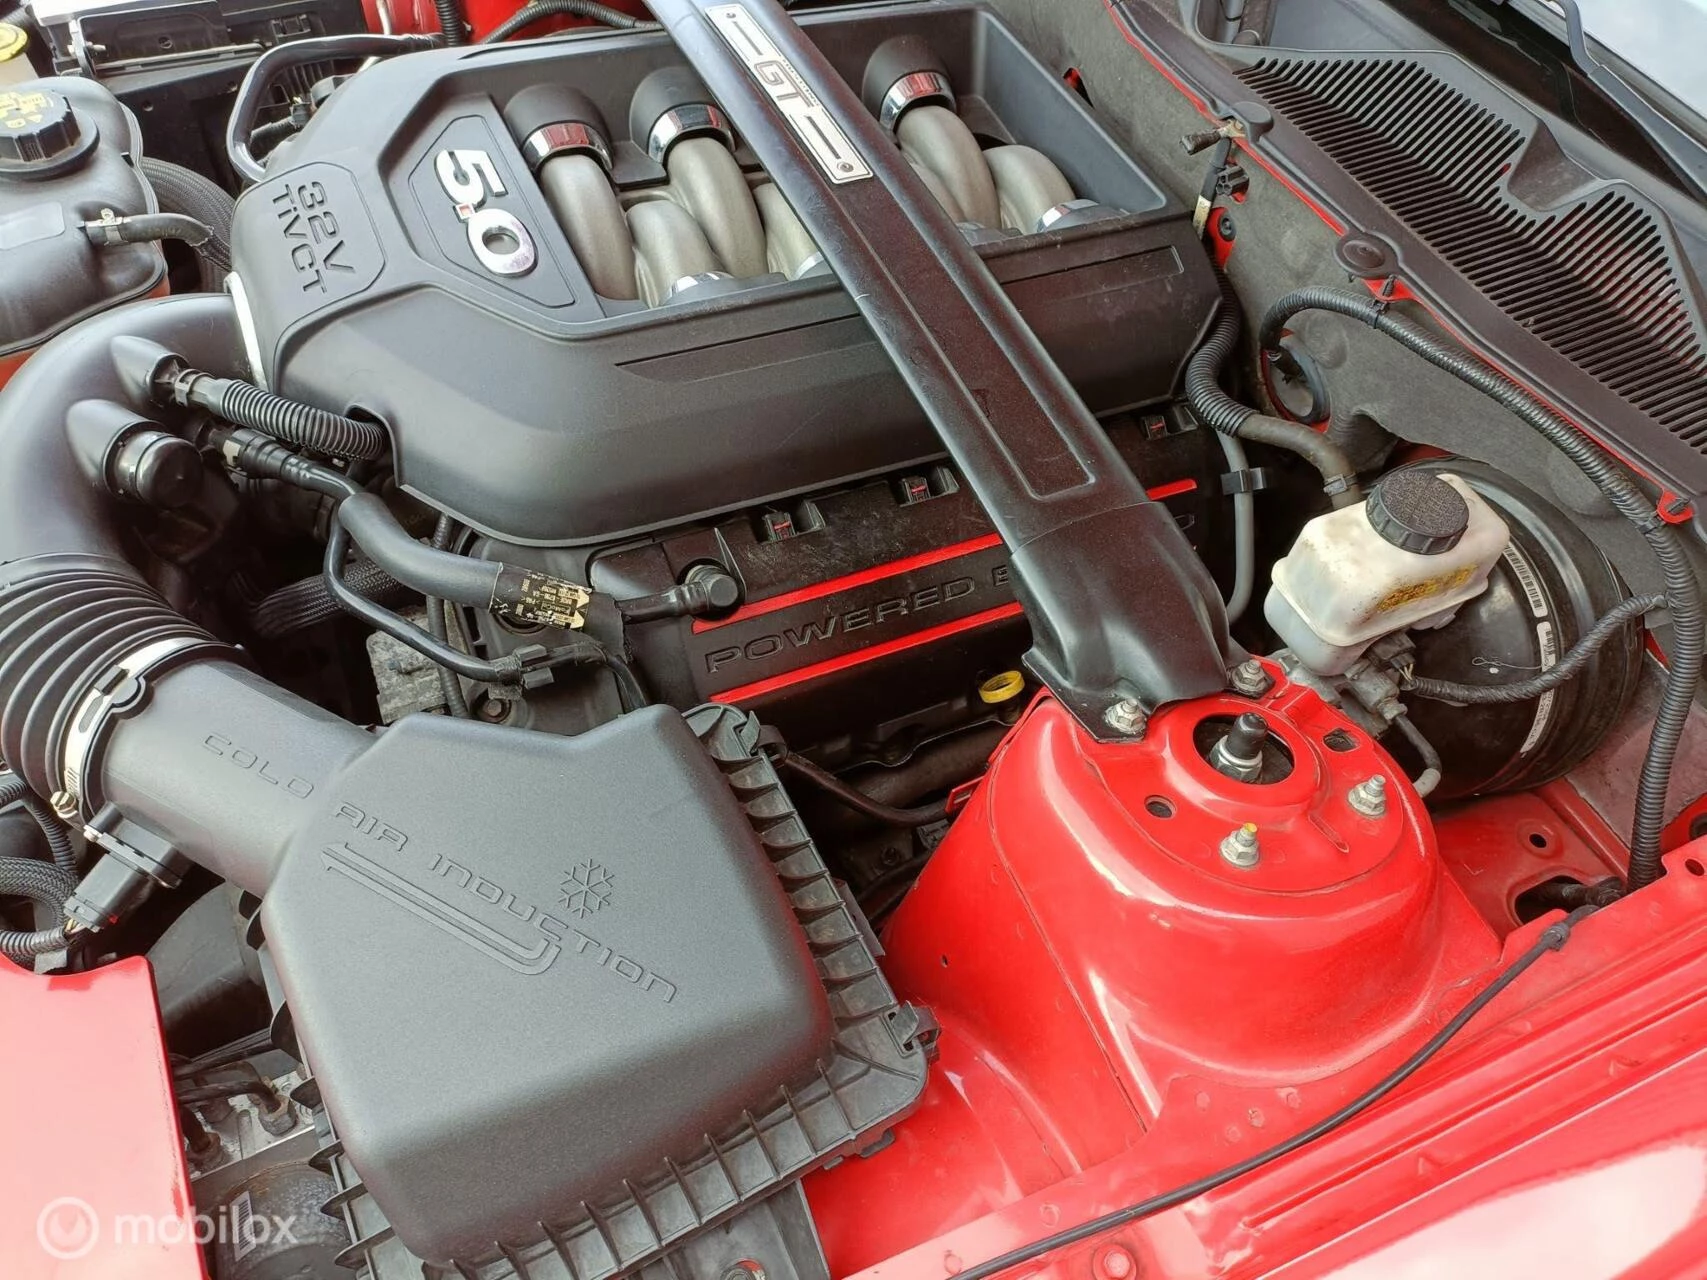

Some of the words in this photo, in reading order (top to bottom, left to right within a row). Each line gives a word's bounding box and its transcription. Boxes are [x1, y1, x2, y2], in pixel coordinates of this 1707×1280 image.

[754, 60, 815, 107] GT
[297, 181, 356, 274] 32V
[434, 149, 539, 278] 5.0
[704, 575, 977, 674] POWERED
[203, 732, 315, 800] COLD
[334, 801, 410, 852] AIR
[431, 852, 678, 1004] INDUCTION
